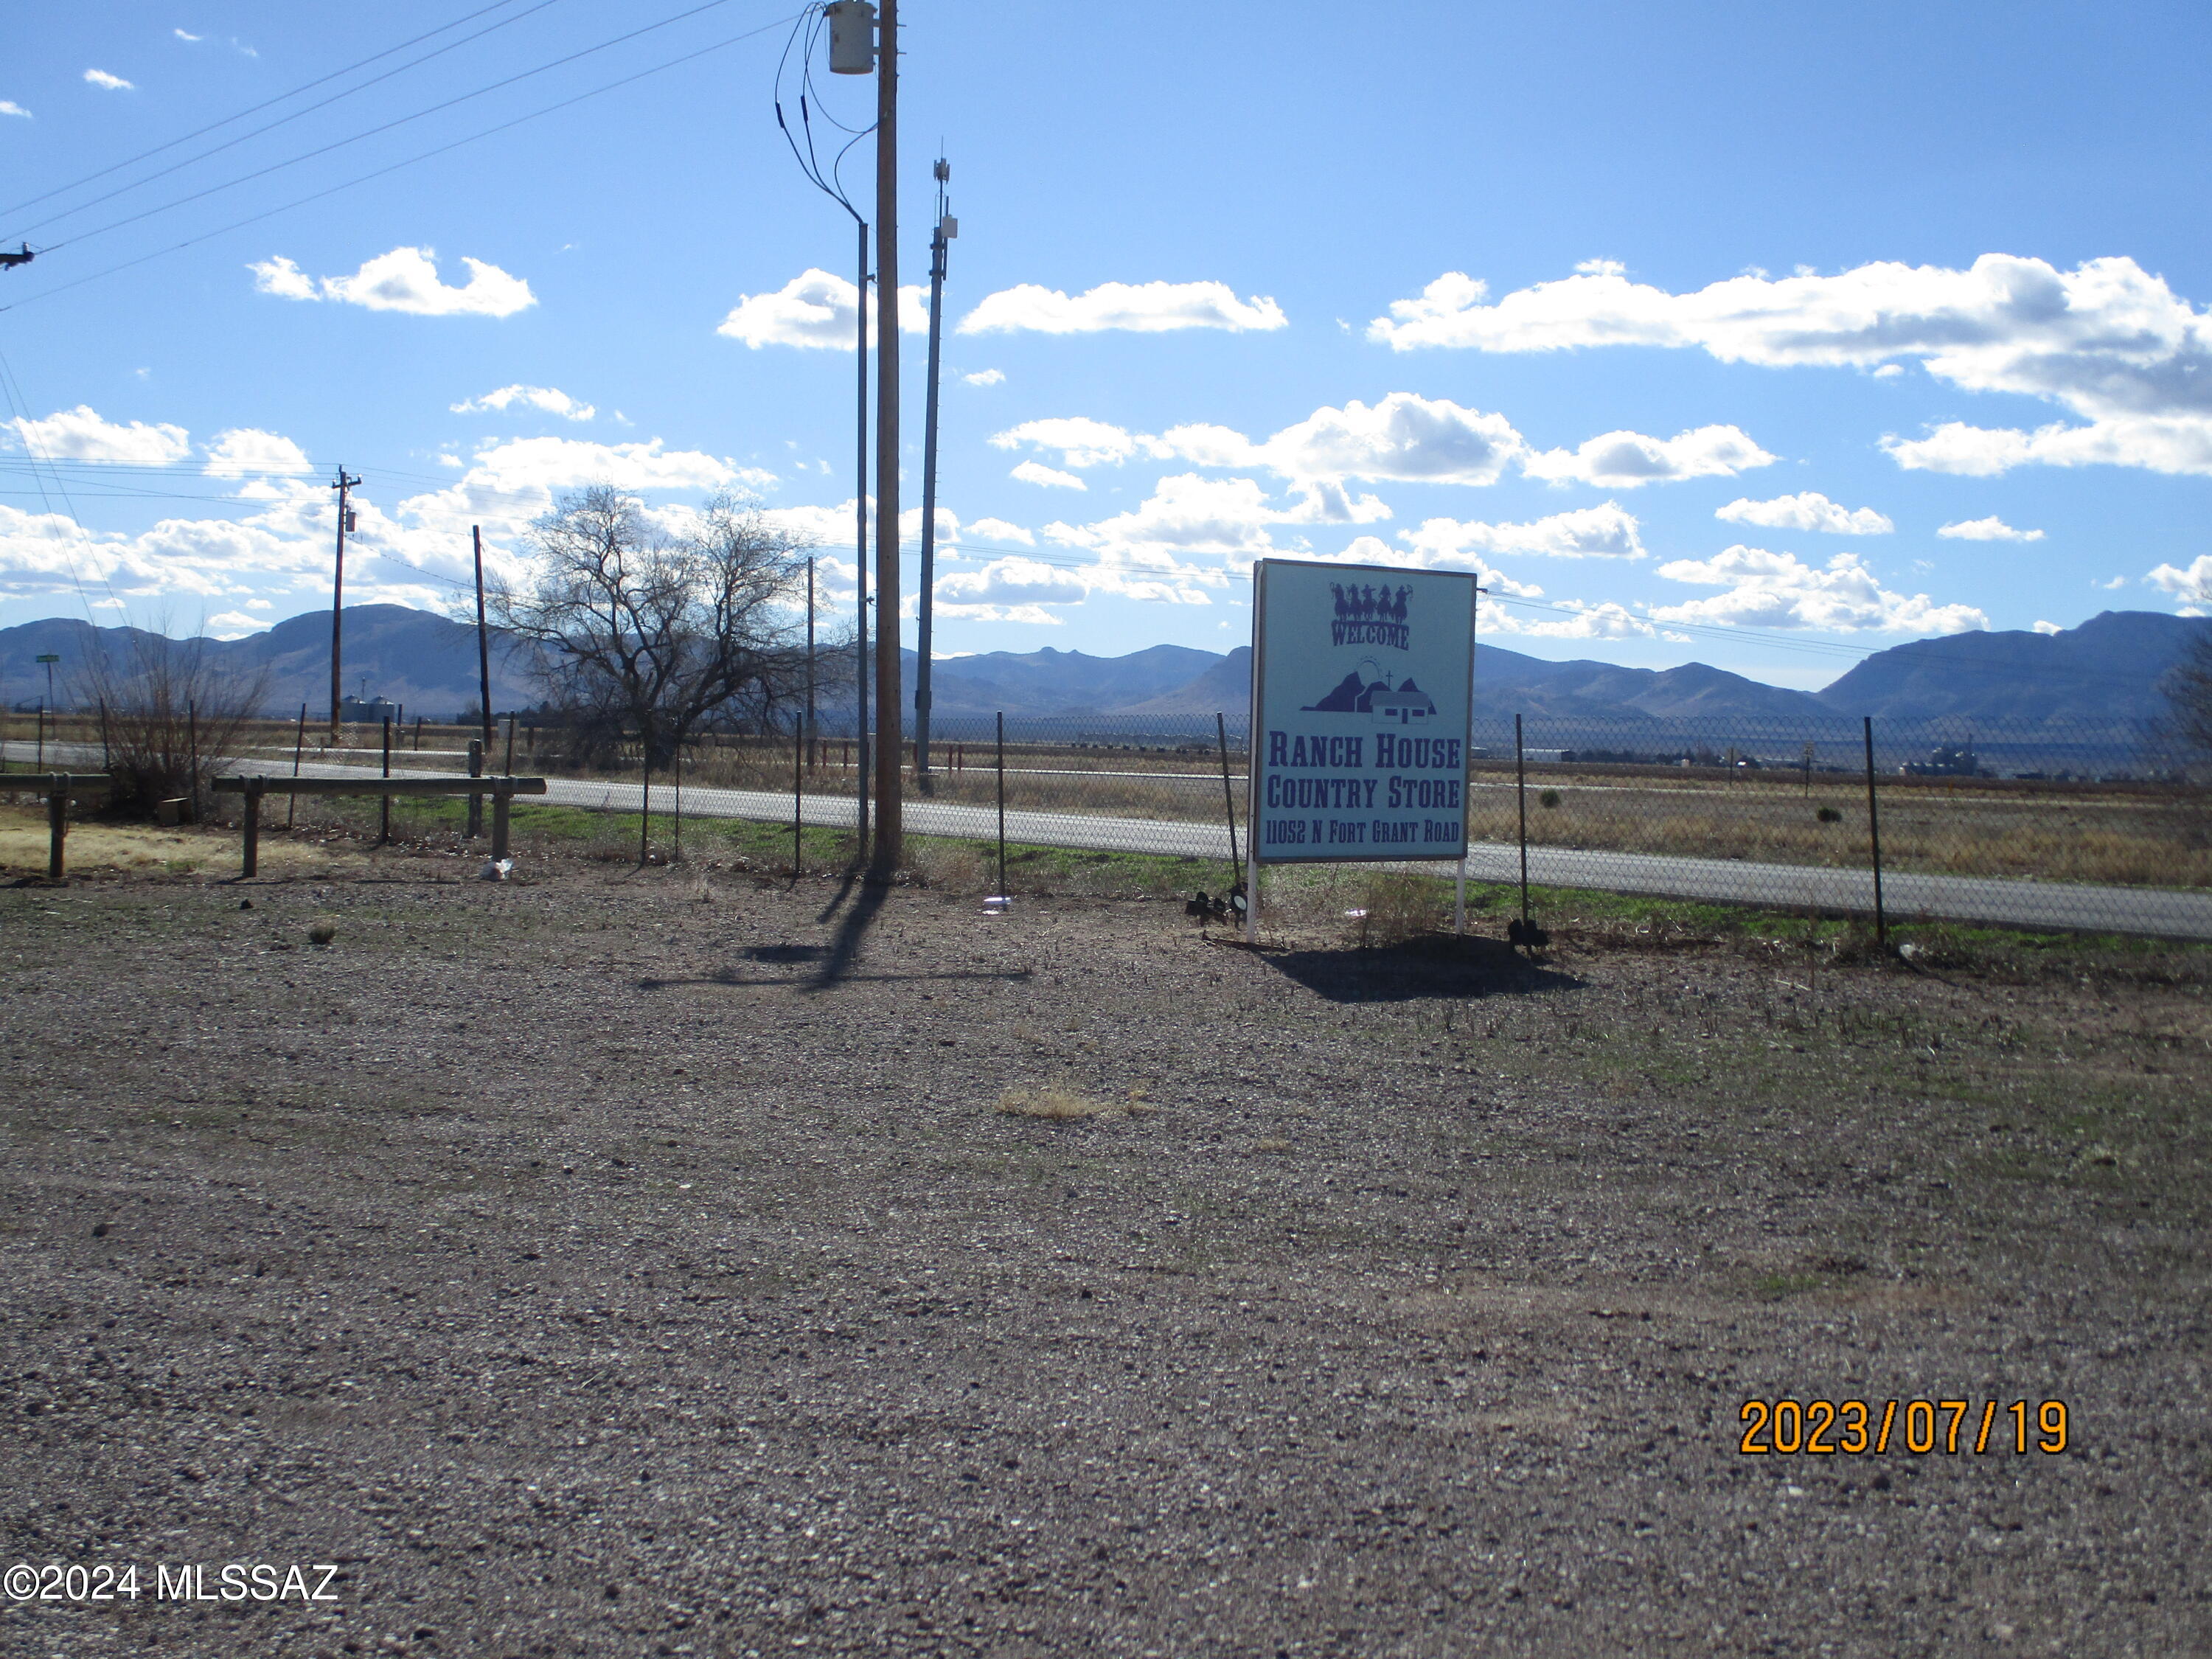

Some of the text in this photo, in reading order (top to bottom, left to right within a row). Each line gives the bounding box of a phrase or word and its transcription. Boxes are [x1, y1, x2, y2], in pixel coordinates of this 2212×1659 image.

[1331, 619, 1409, 650] WELCOME
[1269, 731, 1460, 768] RANCH HOUSE
[1267, 775, 1459, 809] COUNTRY STORE
[1266, 819, 1458, 844] 11052 N FORT GRANT ROAD
